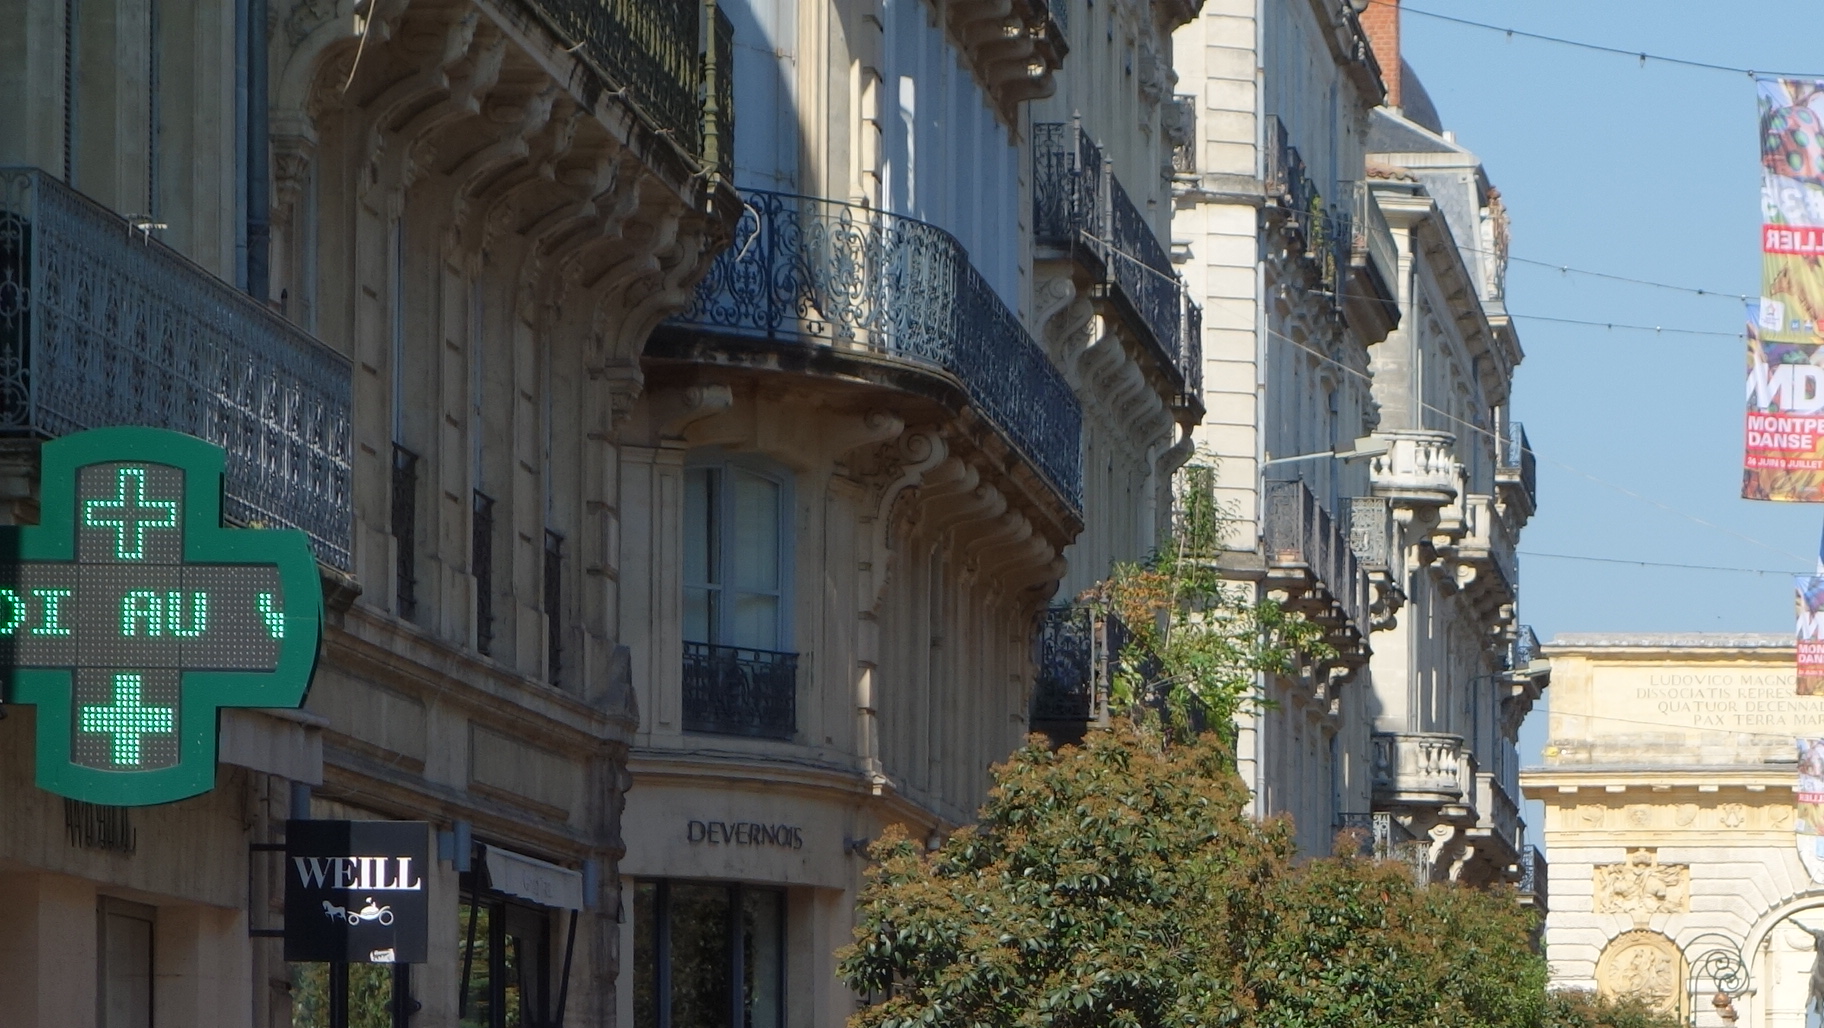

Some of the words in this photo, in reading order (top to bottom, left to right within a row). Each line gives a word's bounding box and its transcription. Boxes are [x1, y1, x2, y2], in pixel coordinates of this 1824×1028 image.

[1748, 432, 1812, 450] DANSE
[1788, 460, 1823, 469] JUILLET
[122, 590, 208, 637] AU
[1650, 674, 1733, 686] LUDOVICO
[1740, 674, 1796, 686] MAGNO
[1636, 688, 1730, 699] DISSOCIATIS
[1658, 700, 1738, 716] QUATUOR
[1694, 714, 1725, 725] PAX
[1733, 714, 1786, 725] TERRA
[687, 820, 803, 850] DEVERNOIS
[292, 856, 422, 890] WEILL
